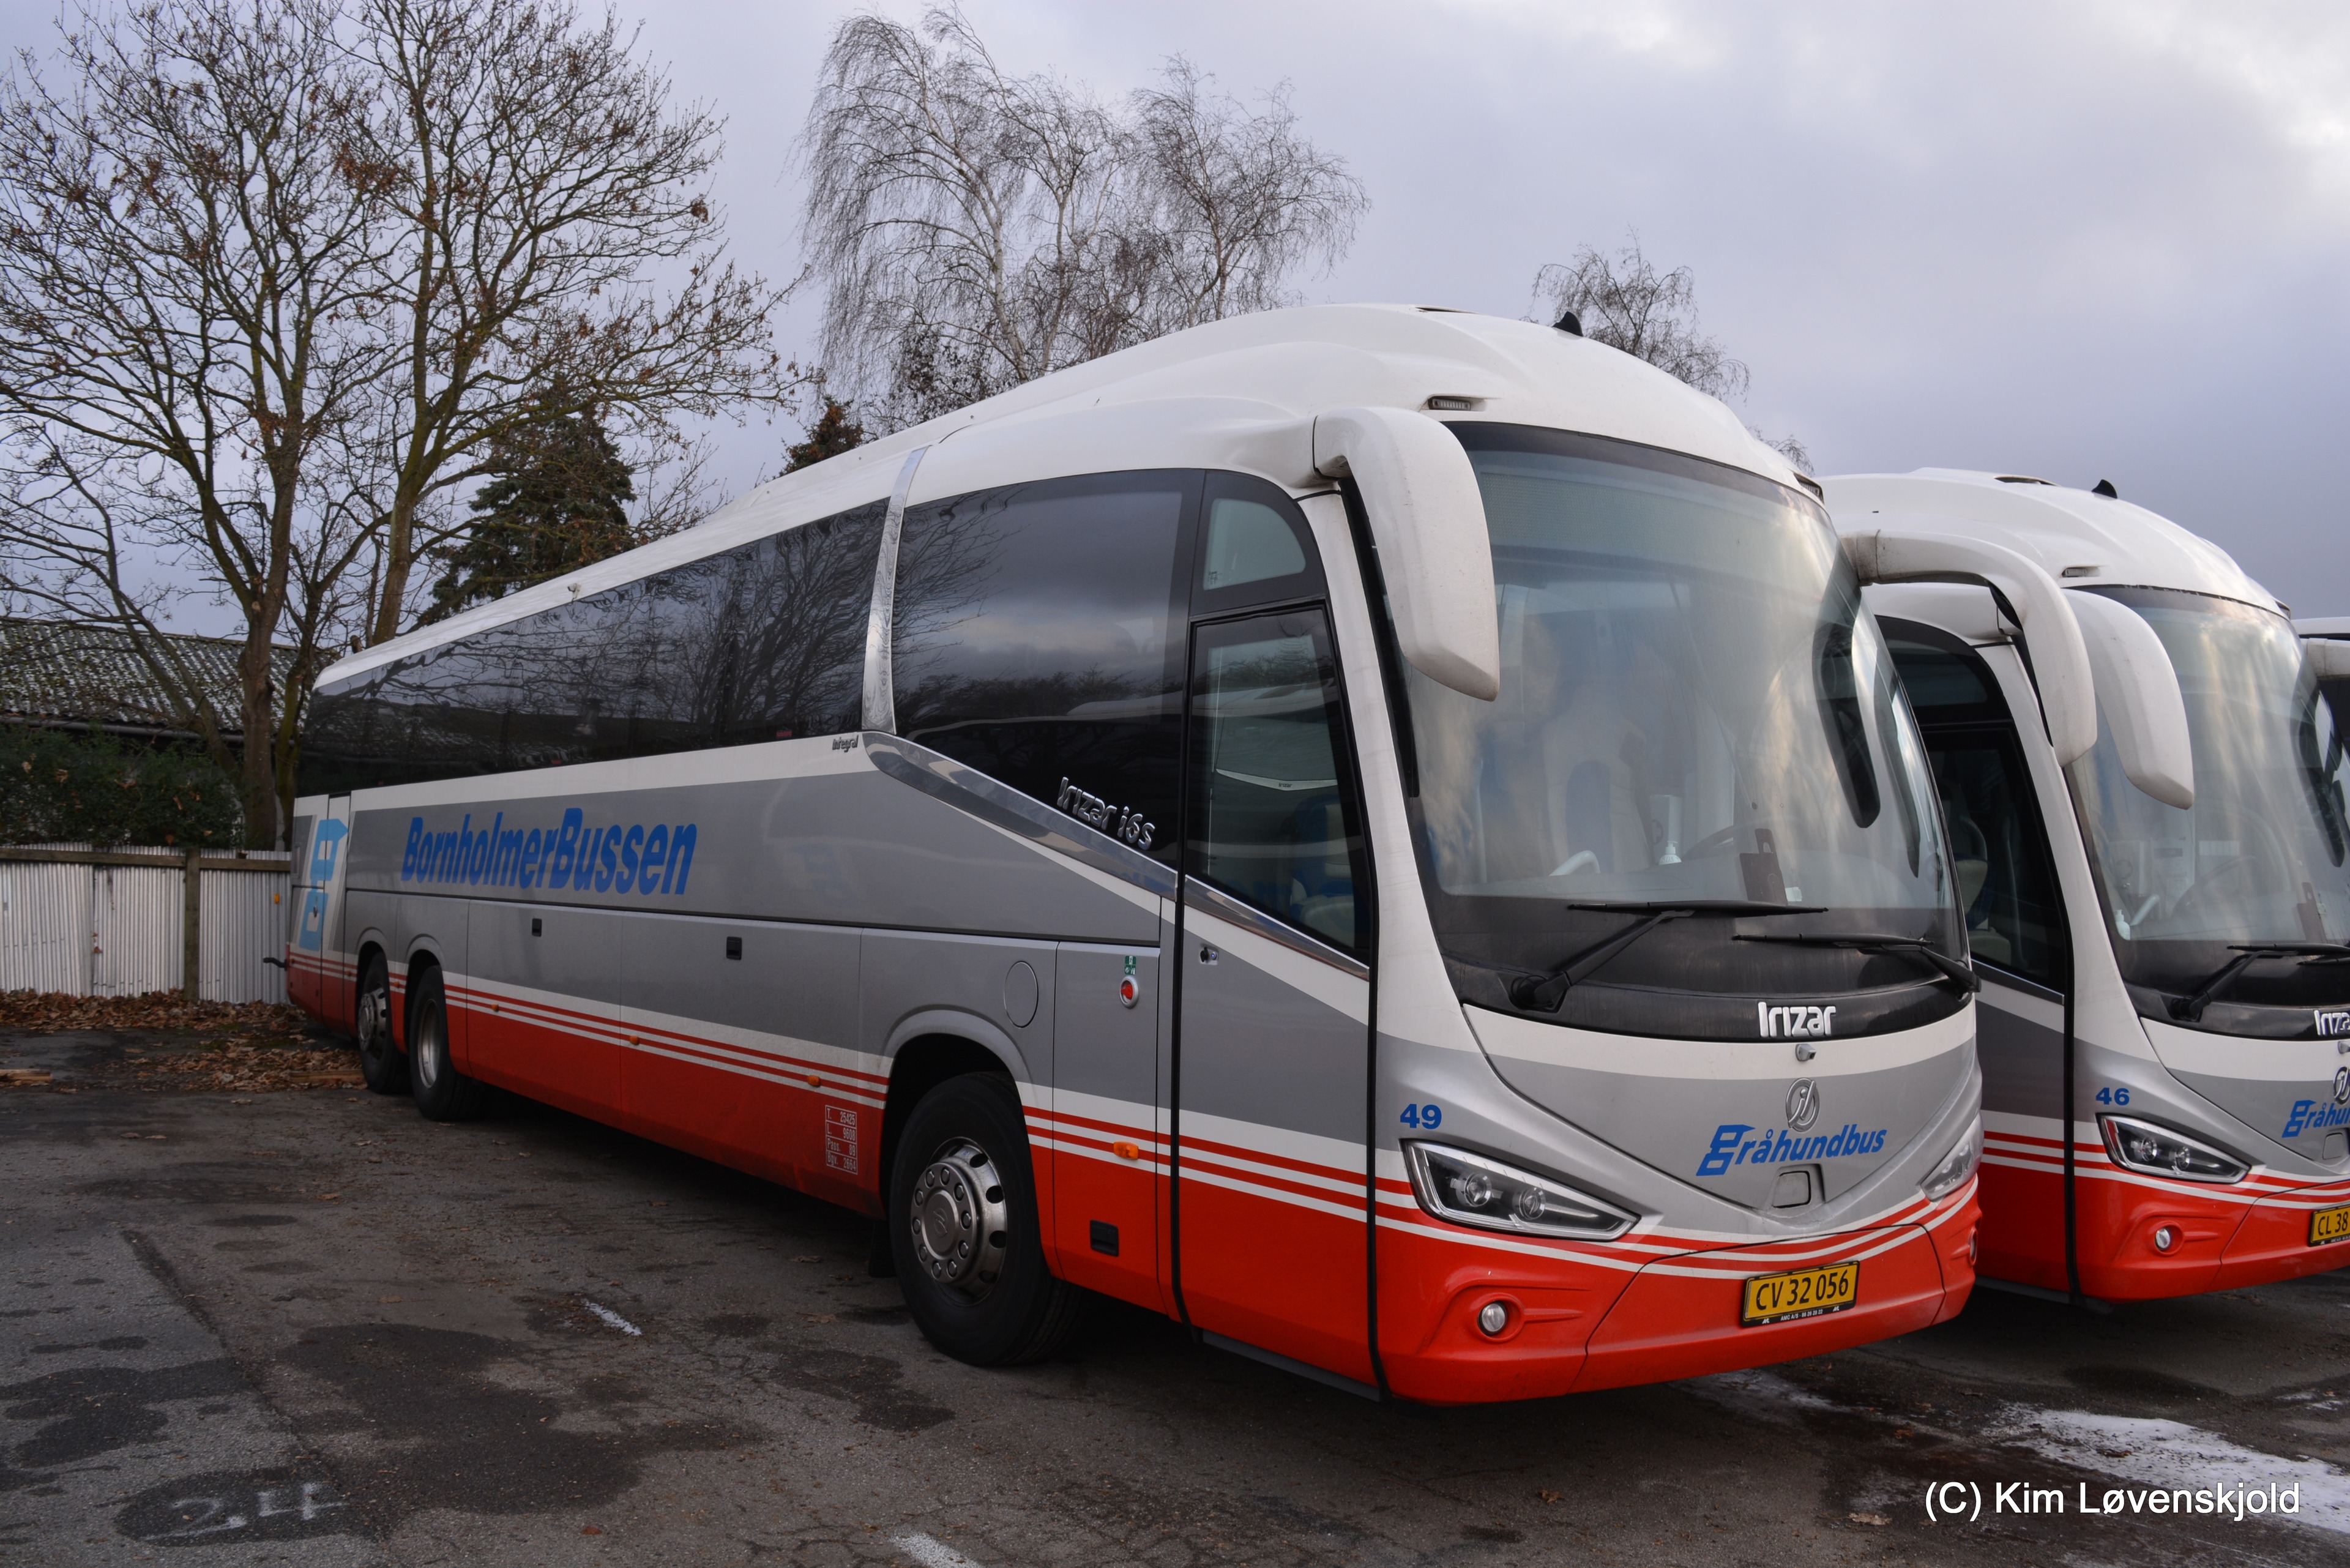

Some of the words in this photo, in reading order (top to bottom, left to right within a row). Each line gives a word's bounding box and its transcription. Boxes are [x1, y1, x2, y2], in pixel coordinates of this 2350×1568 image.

[1057, 777, 1117, 831] Irizar
[401, 807, 697, 895] BornholmerBussen
[1758, 1001, 1836, 1037] Irizar
[2095, 1087, 2130, 1106] 46
[840, 1111, 856, 1126] 25425
[1400, 1103, 1442, 1130] 49
[843, 1127, 856, 1141] 9608
[827, 1138, 841, 1152] Pass.
[849, 1144, 856, 1156] 89
[843, 1157, 857, 1171] 2664
[2318, 1215, 2331, 1236] CL
[2335, 1211, 2348, 1233] 38
[1756, 1281, 1783, 1310] CV
[1786, 1277, 1811, 1306] 32
[1816, 1269, 1848, 1301] 056
